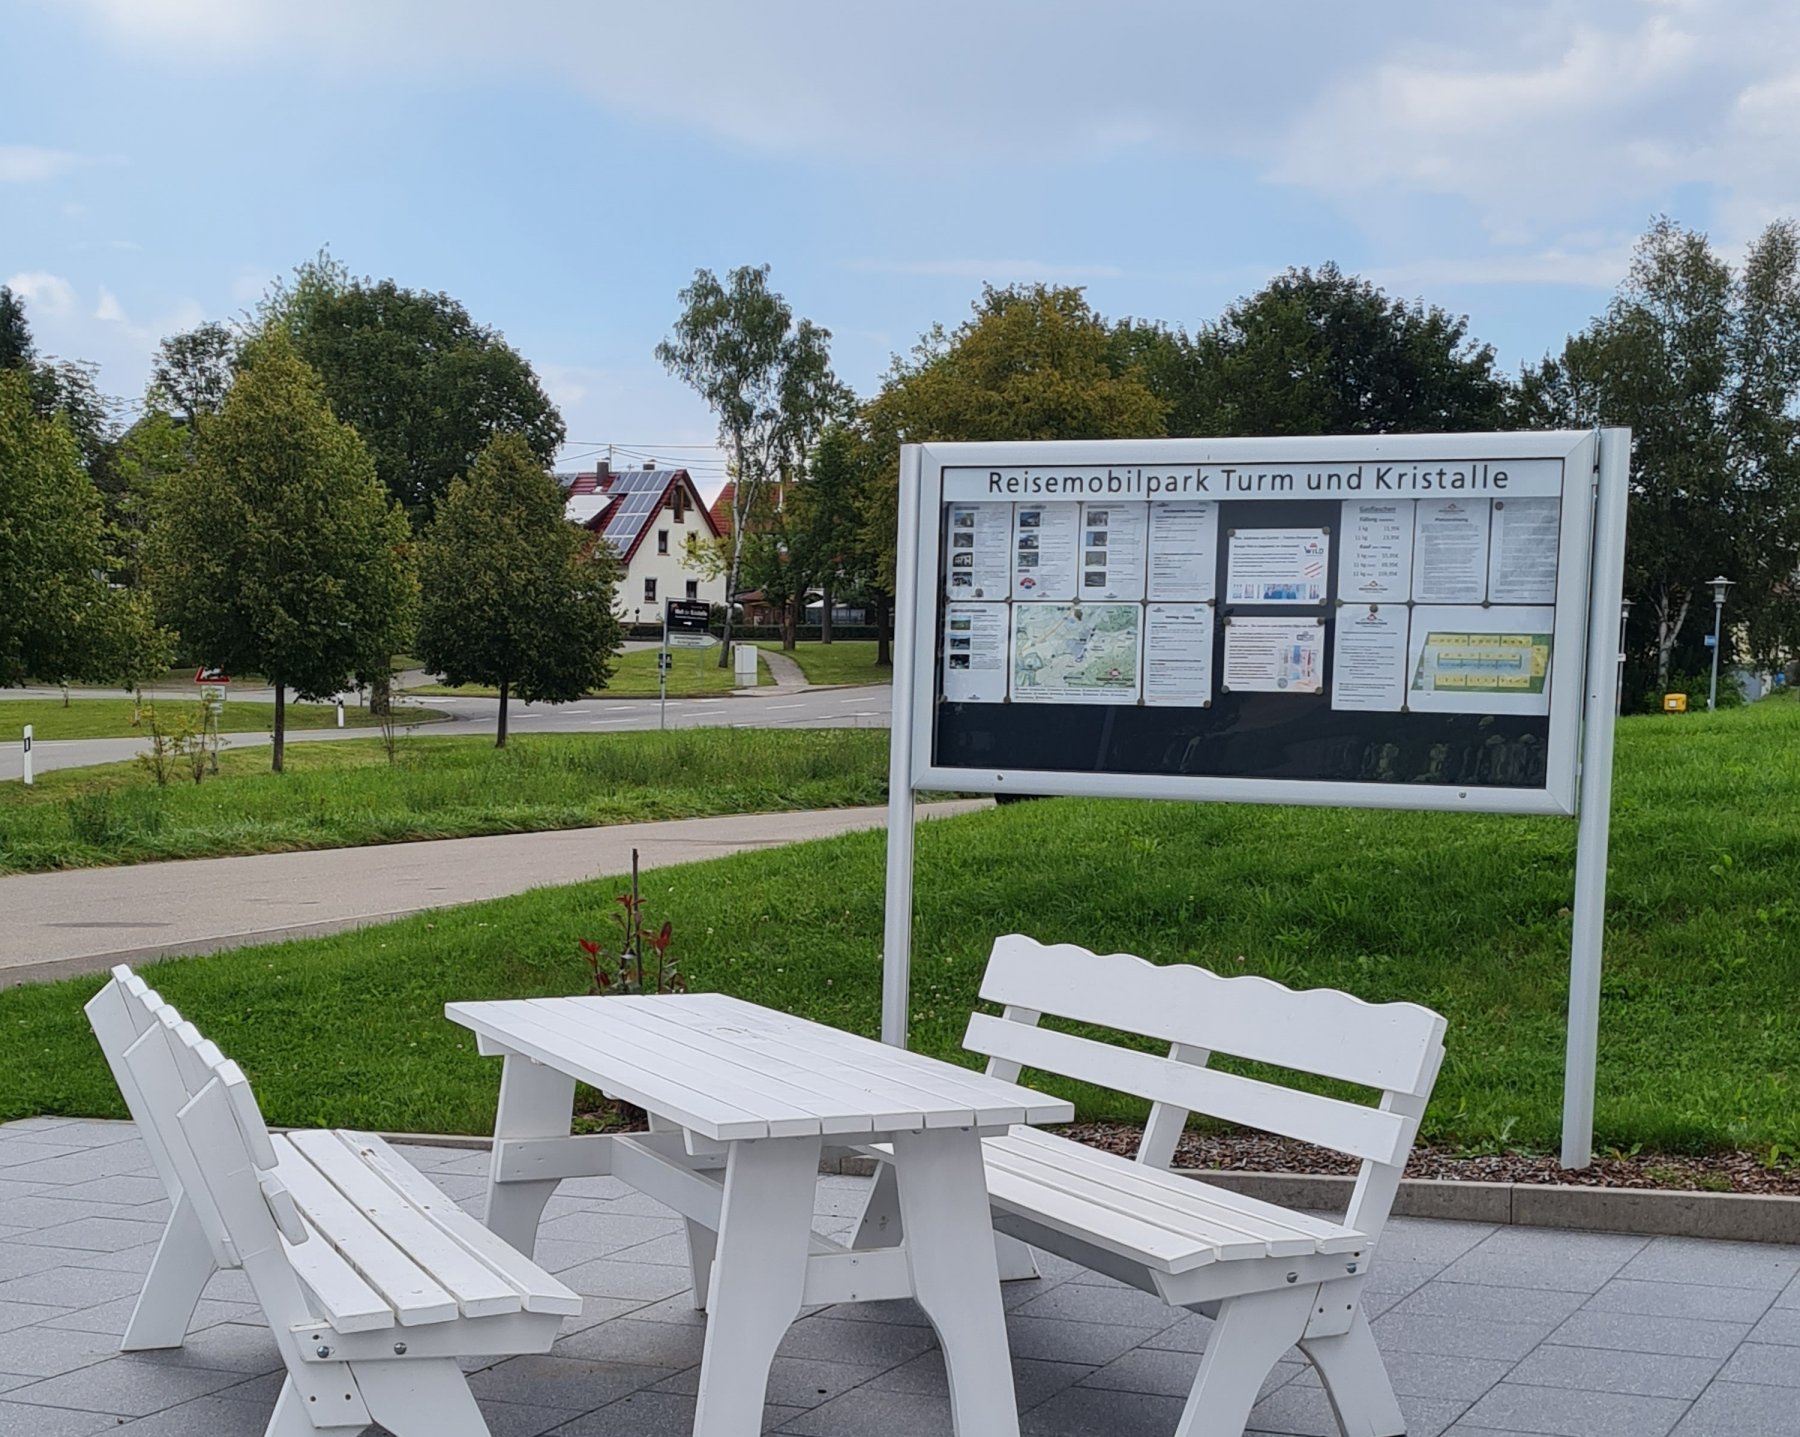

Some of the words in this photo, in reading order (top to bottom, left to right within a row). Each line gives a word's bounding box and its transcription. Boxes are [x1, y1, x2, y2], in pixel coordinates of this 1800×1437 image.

[989, 468, 1210, 498] Reisemobilpark
[1221, 469, 1294, 492] Turm
[1307, 466, 1362, 491] und
[1376, 465, 1509, 490] Kristalle
